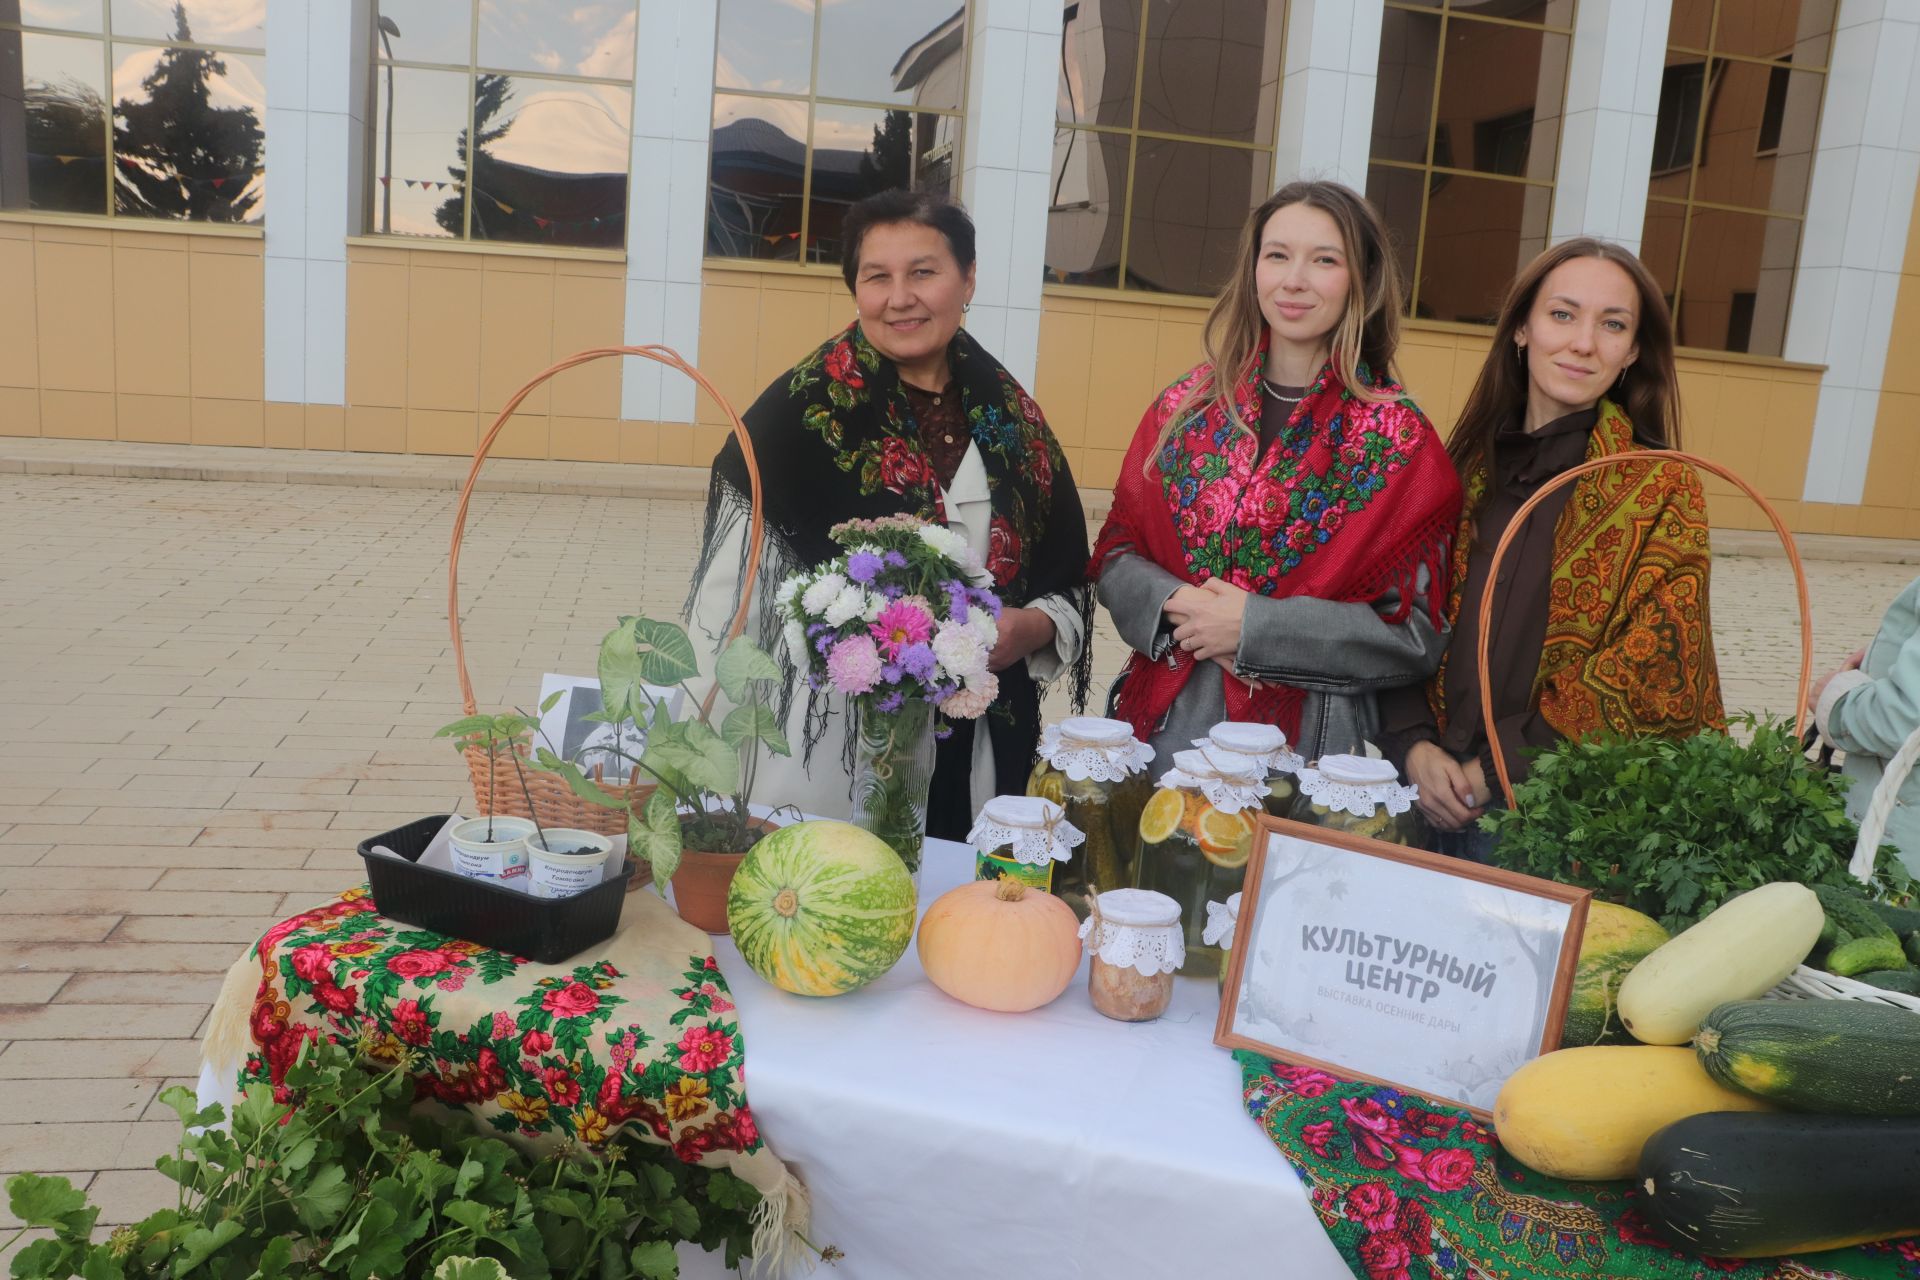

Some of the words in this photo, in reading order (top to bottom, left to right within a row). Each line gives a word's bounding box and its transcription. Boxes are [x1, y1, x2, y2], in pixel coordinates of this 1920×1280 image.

[1302, 925, 1497, 998] КУЛЬТУРНЫЙ
[1346, 959, 1440, 1003] ЦЕНТР
[1317, 985, 1372, 1010] ВЫСТАВКА
[1376, 1002, 1425, 1024] ОСЕННИЕ
[1427, 1016, 1461, 1033] ДАРЫ
